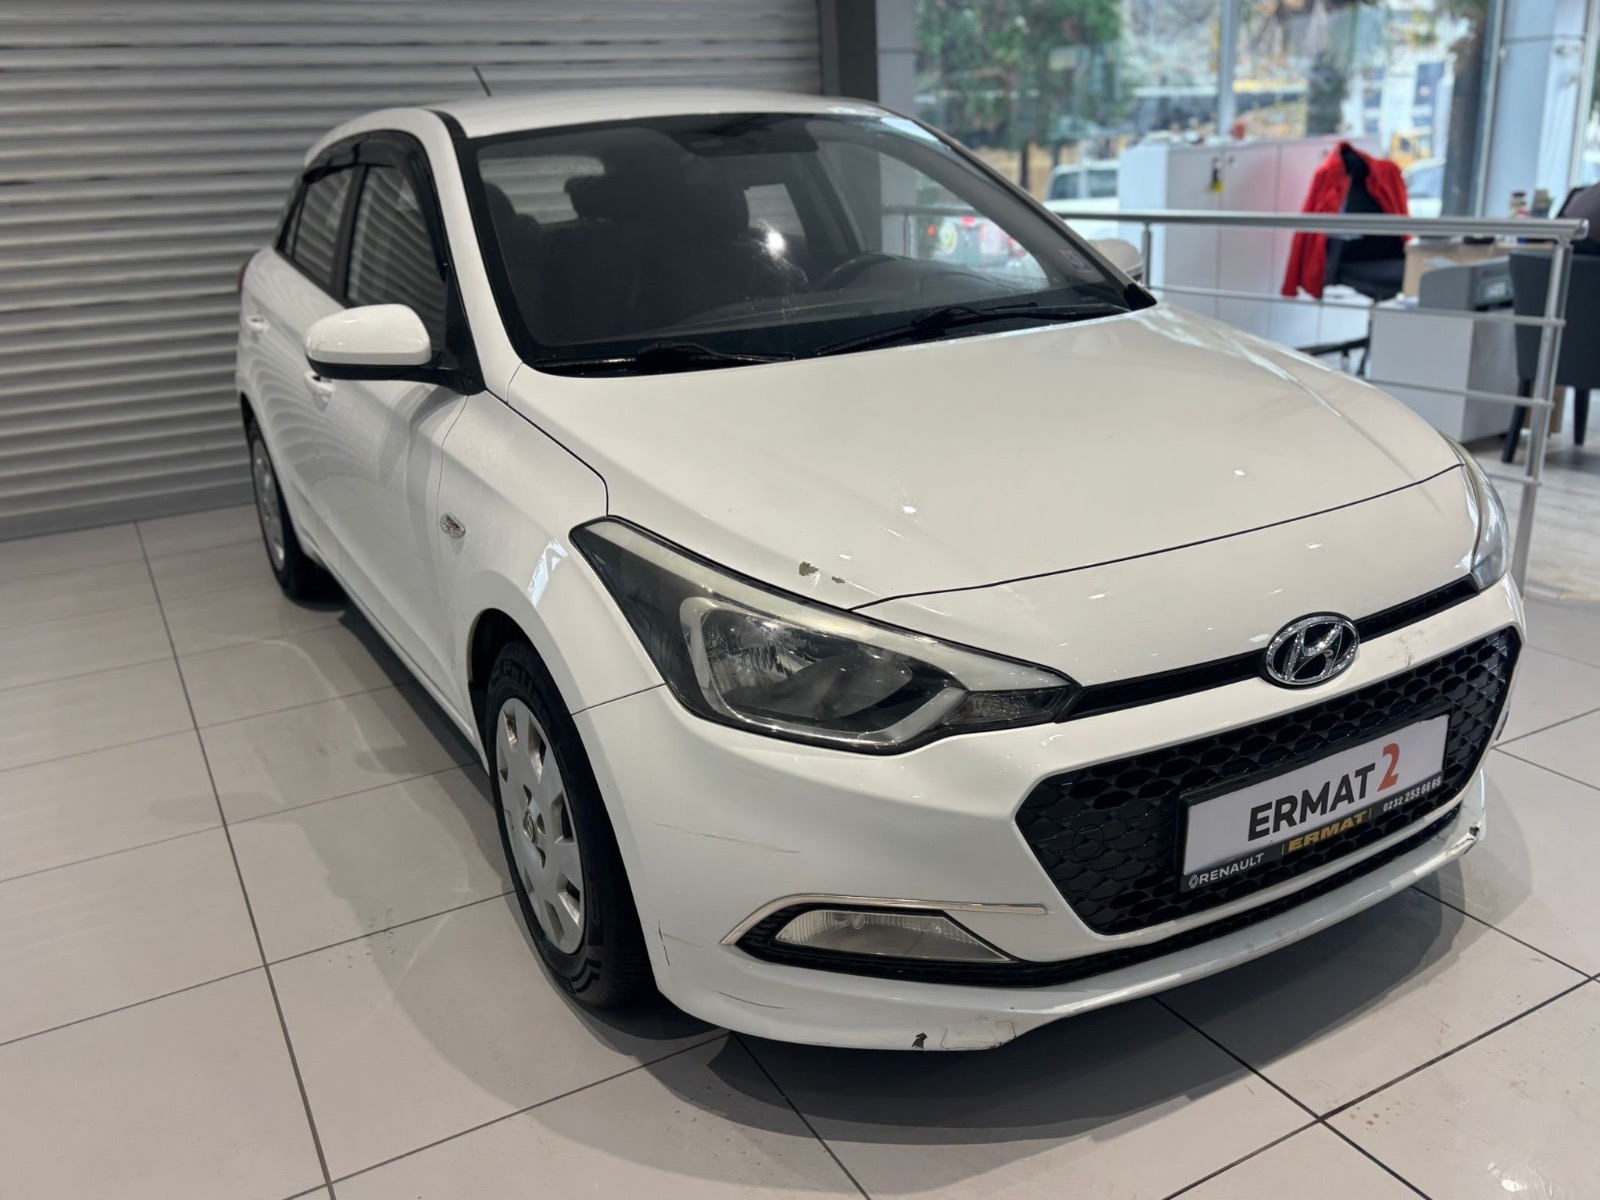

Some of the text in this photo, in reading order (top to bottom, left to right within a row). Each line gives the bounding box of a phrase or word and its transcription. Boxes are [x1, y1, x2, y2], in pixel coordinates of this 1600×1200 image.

[1198, 852, 1264, 885] RENAULT
[1288, 809, 1369, 852] ERMAT
[1382, 796, 1404, 812] 0232
[1404, 787, 1421, 803] 253
[1247, 762, 1376, 842] ERMAT
